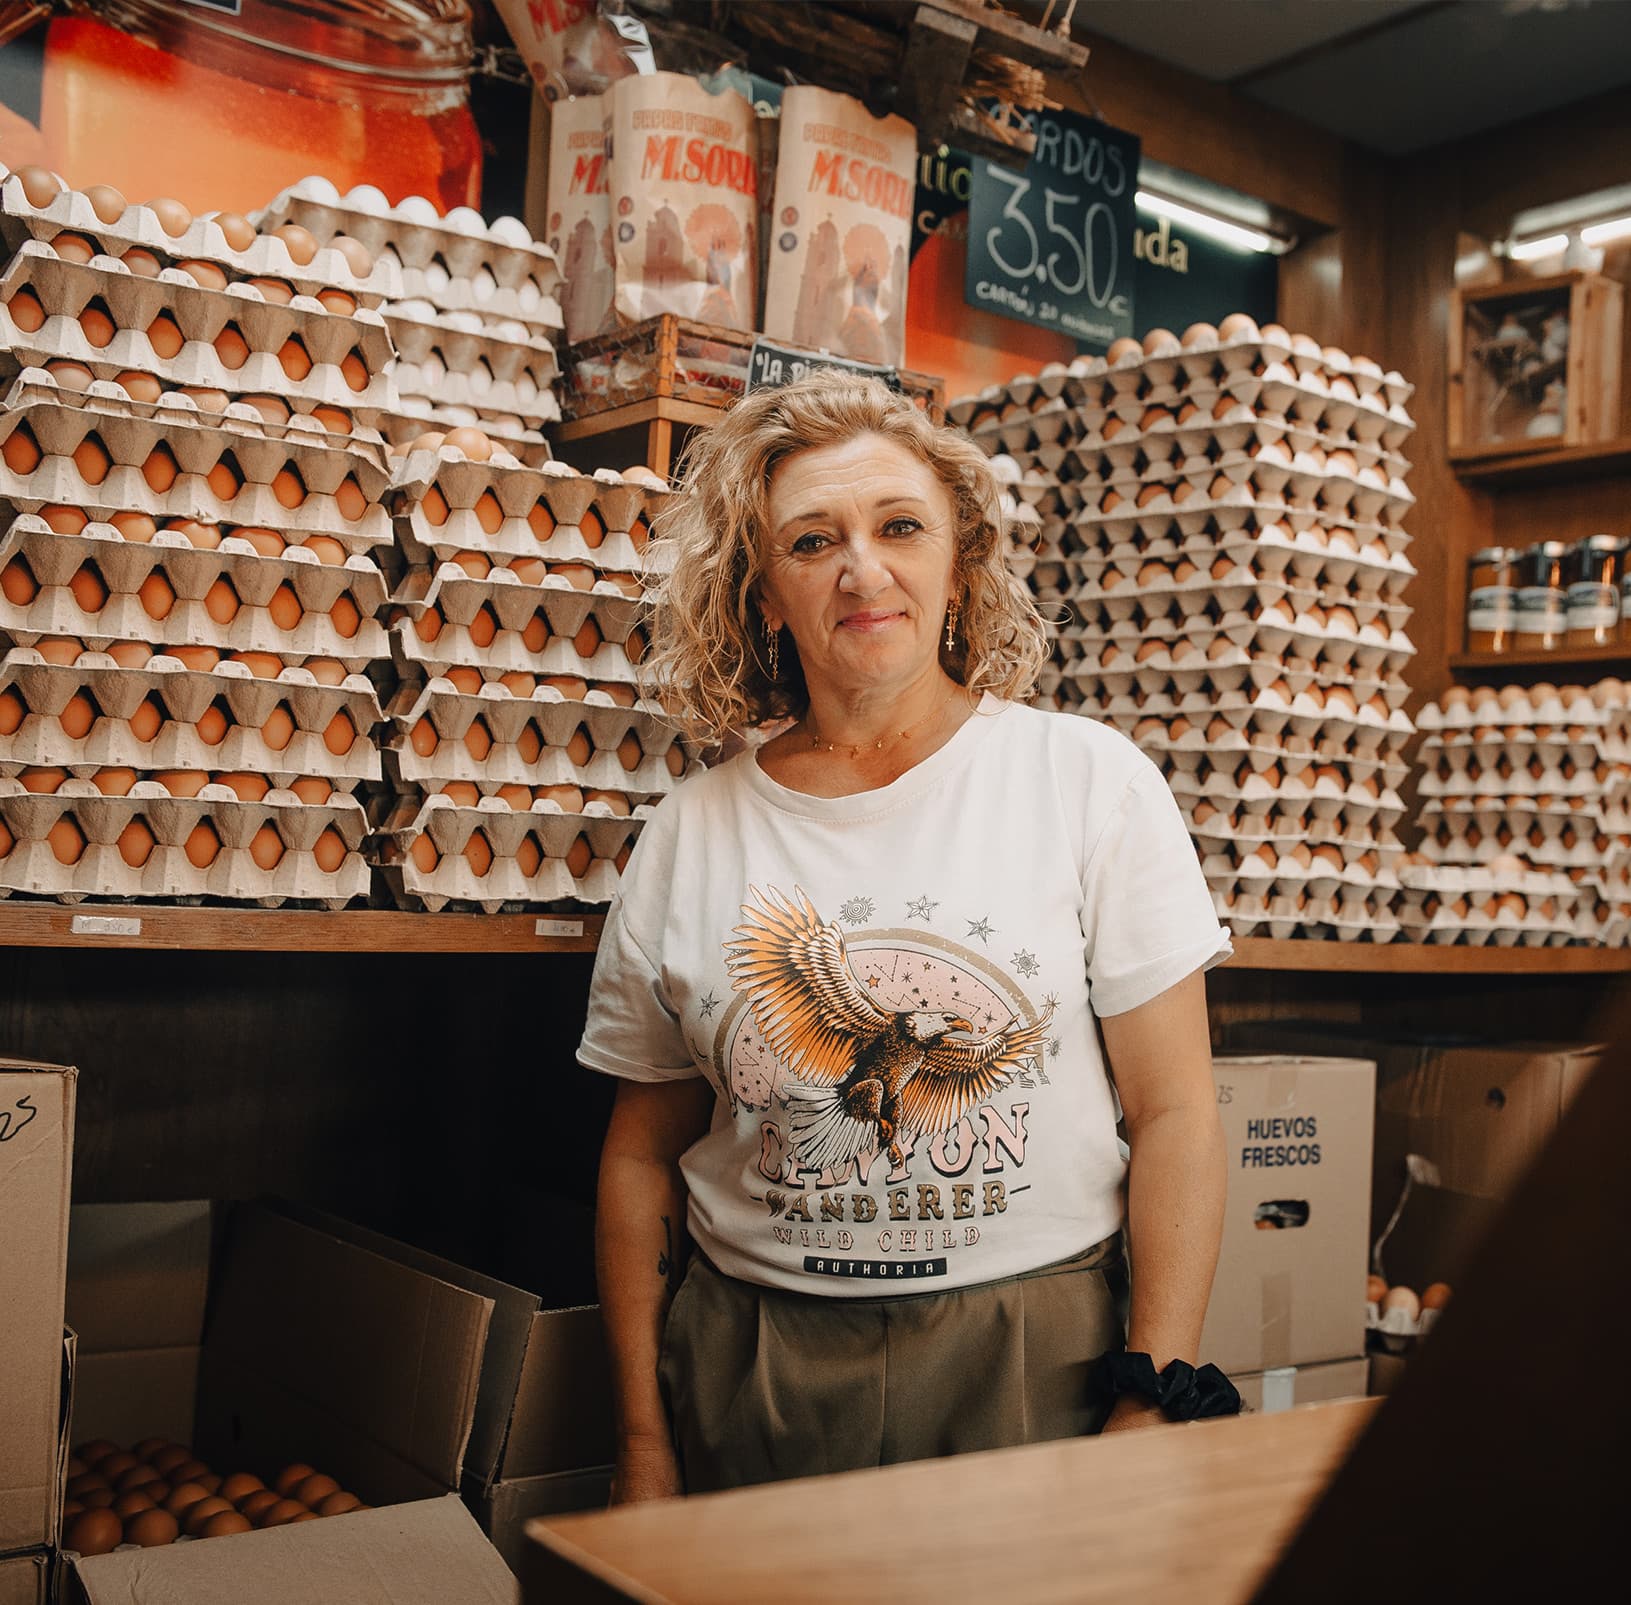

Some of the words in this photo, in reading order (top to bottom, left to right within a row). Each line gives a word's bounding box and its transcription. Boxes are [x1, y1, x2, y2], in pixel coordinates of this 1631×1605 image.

[1247, 1116, 1318, 1140] HUEVOS
[1241, 1144, 1322, 1169] FRESCOS
[773, 1226, 854, 1251] WILD
[877, 1226, 981, 1252] CHILD
[815, 1260, 934, 1277] AUTHORIA
